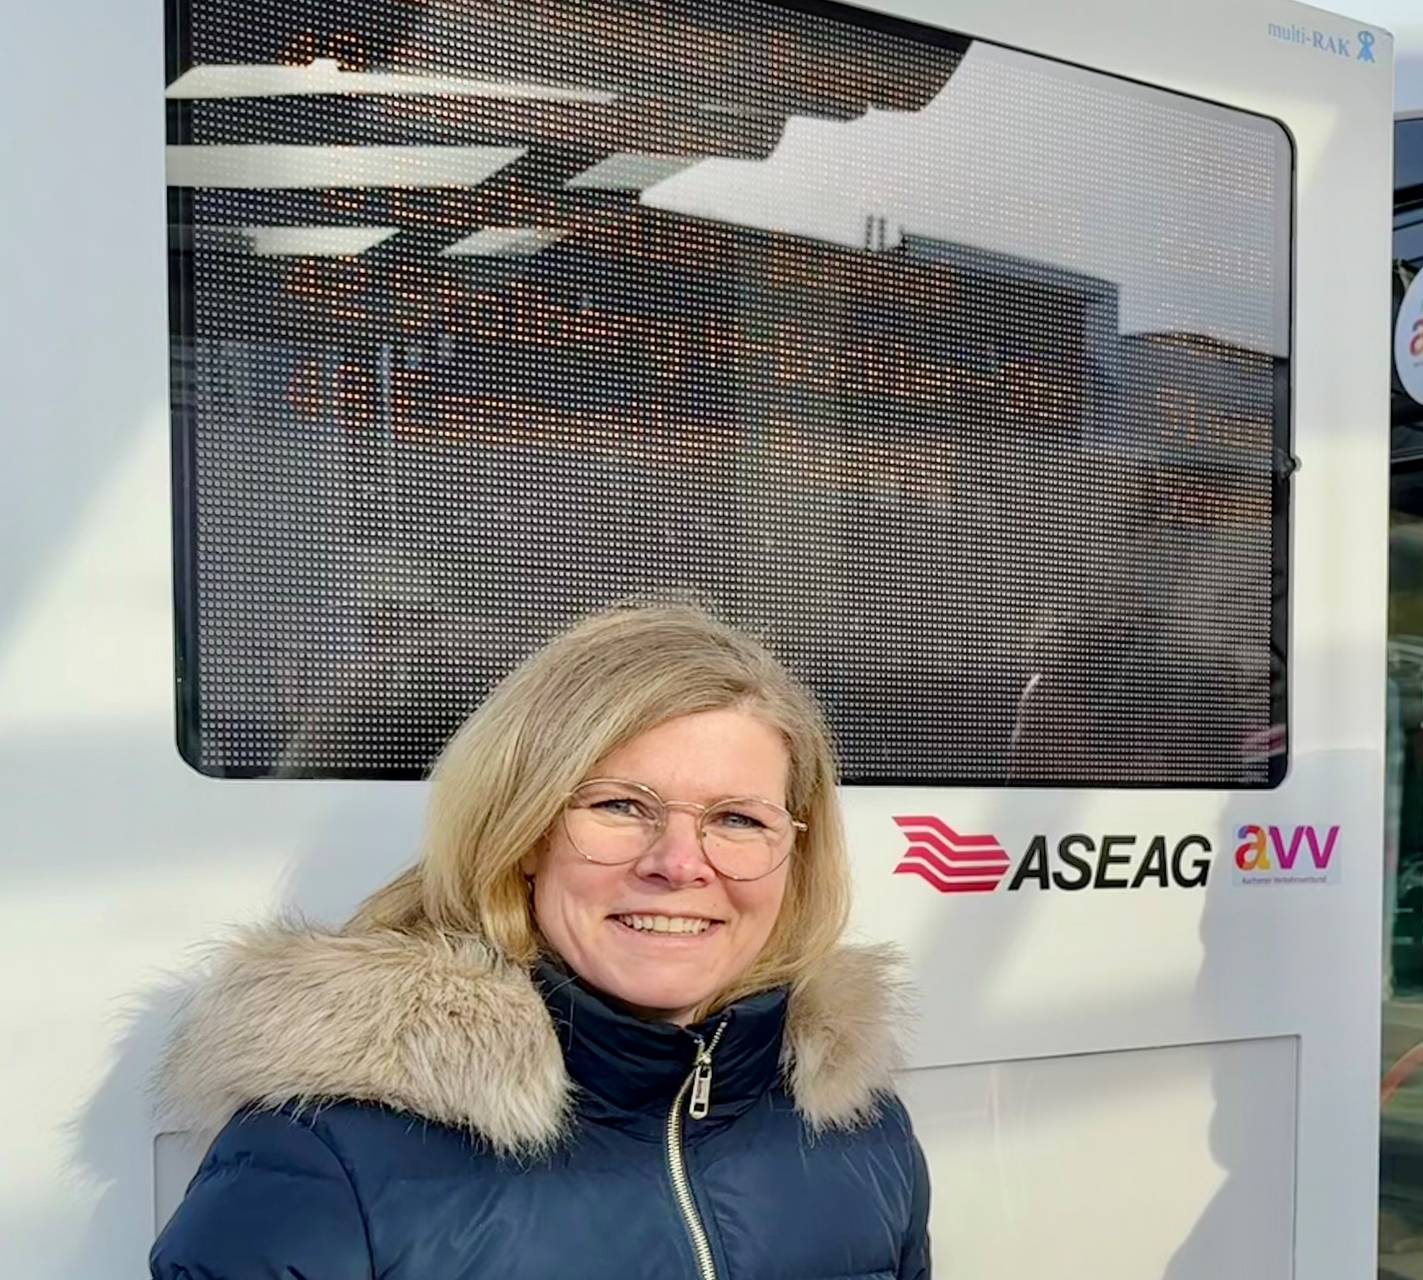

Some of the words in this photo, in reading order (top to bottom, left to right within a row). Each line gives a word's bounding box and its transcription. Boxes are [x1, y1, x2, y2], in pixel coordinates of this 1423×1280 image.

[1267, 22, 1350, 57] multi-RAK
[1008, 834, 1213, 890] ASEAG
[1235, 825, 1340, 870] avv
